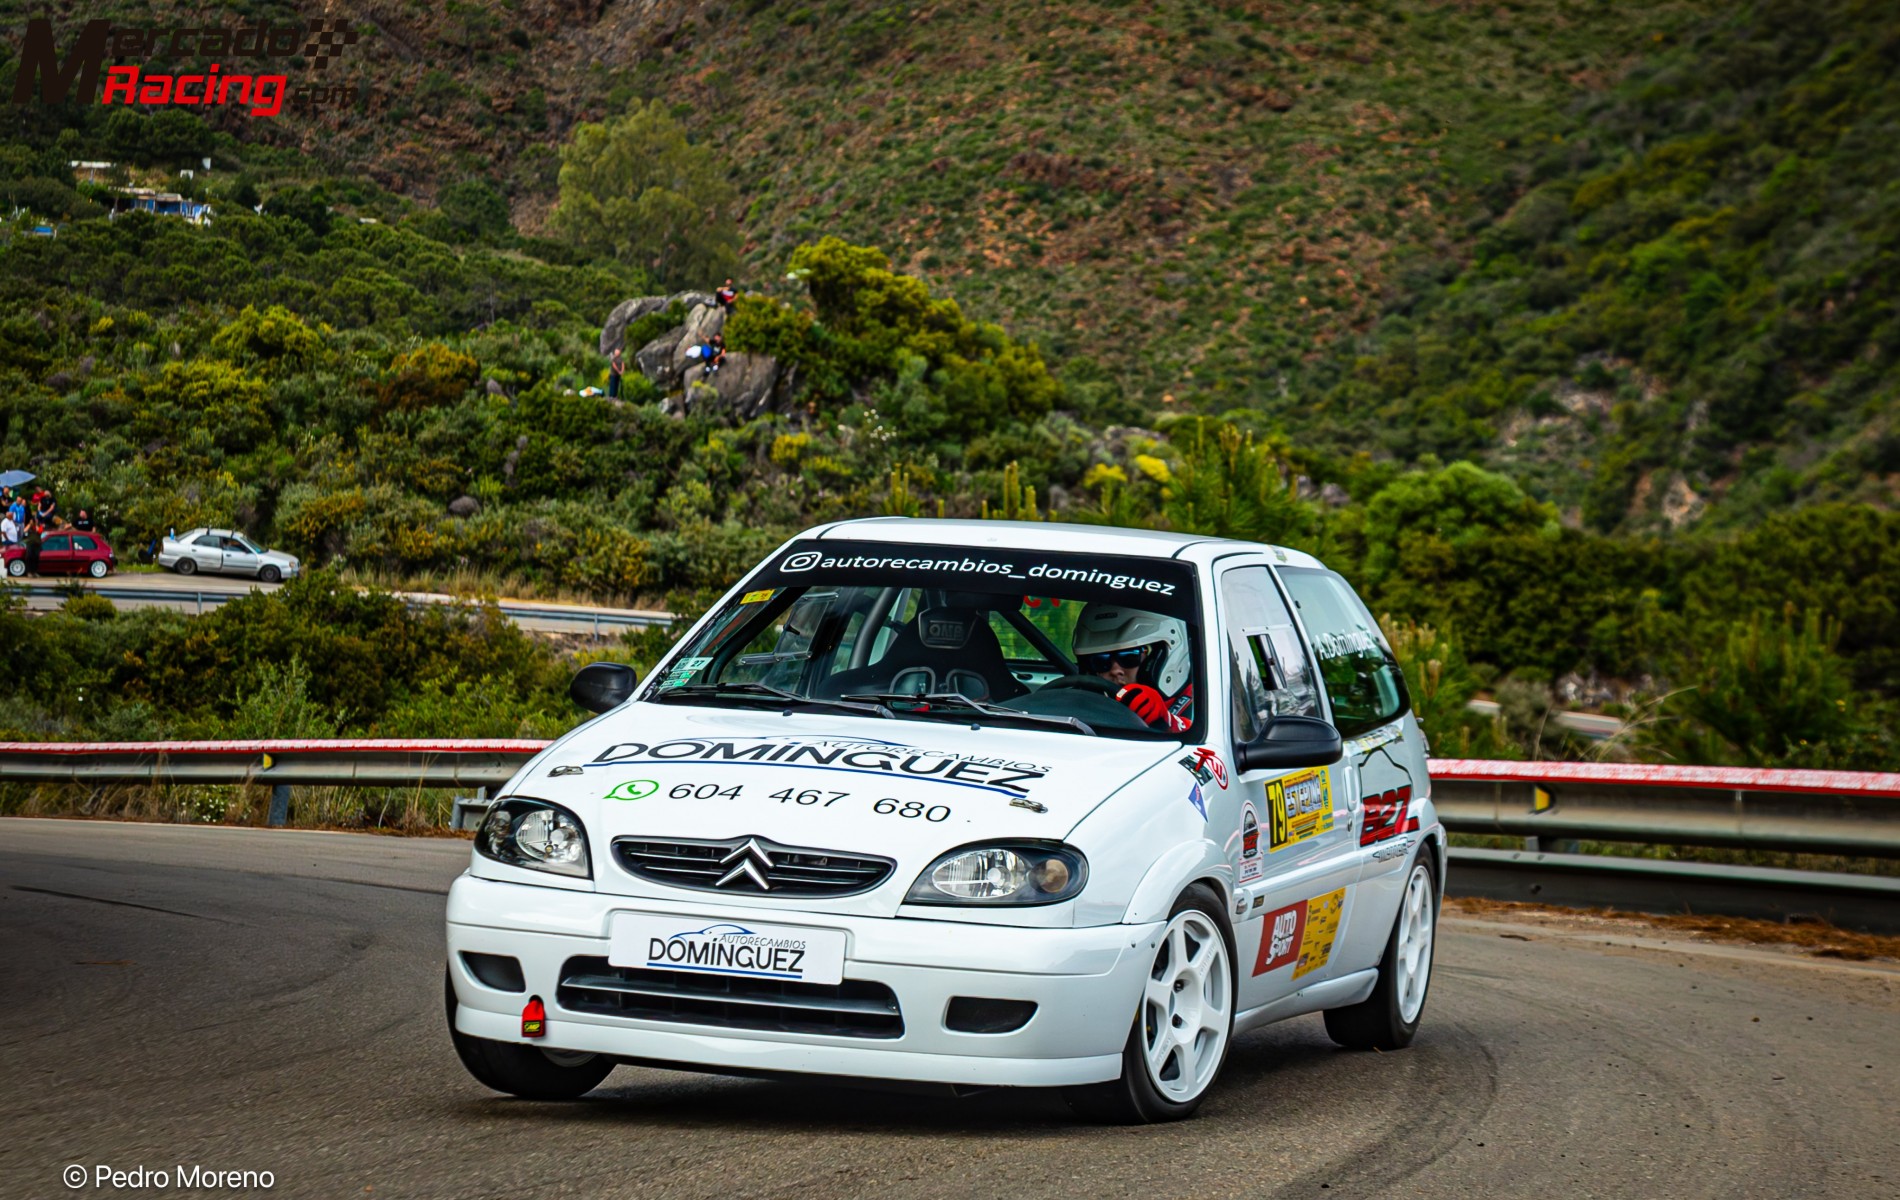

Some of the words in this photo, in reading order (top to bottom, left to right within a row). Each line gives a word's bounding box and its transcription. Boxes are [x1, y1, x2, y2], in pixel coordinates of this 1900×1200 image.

[820, 556, 1175, 596] autorecambios_dominguez
[818, 740, 1053, 774] AUTORECAMBIOS
[668, 783, 744, 800] 604
[768, 787, 851, 809] 467
[873, 798, 952, 823] 680
[1267, 782, 1286, 844] 79
[1360, 784, 1420, 848] B27
[717, 934, 806, 950] AUTORECAMBIOS
[1272, 909, 1297, 940] AUTO
